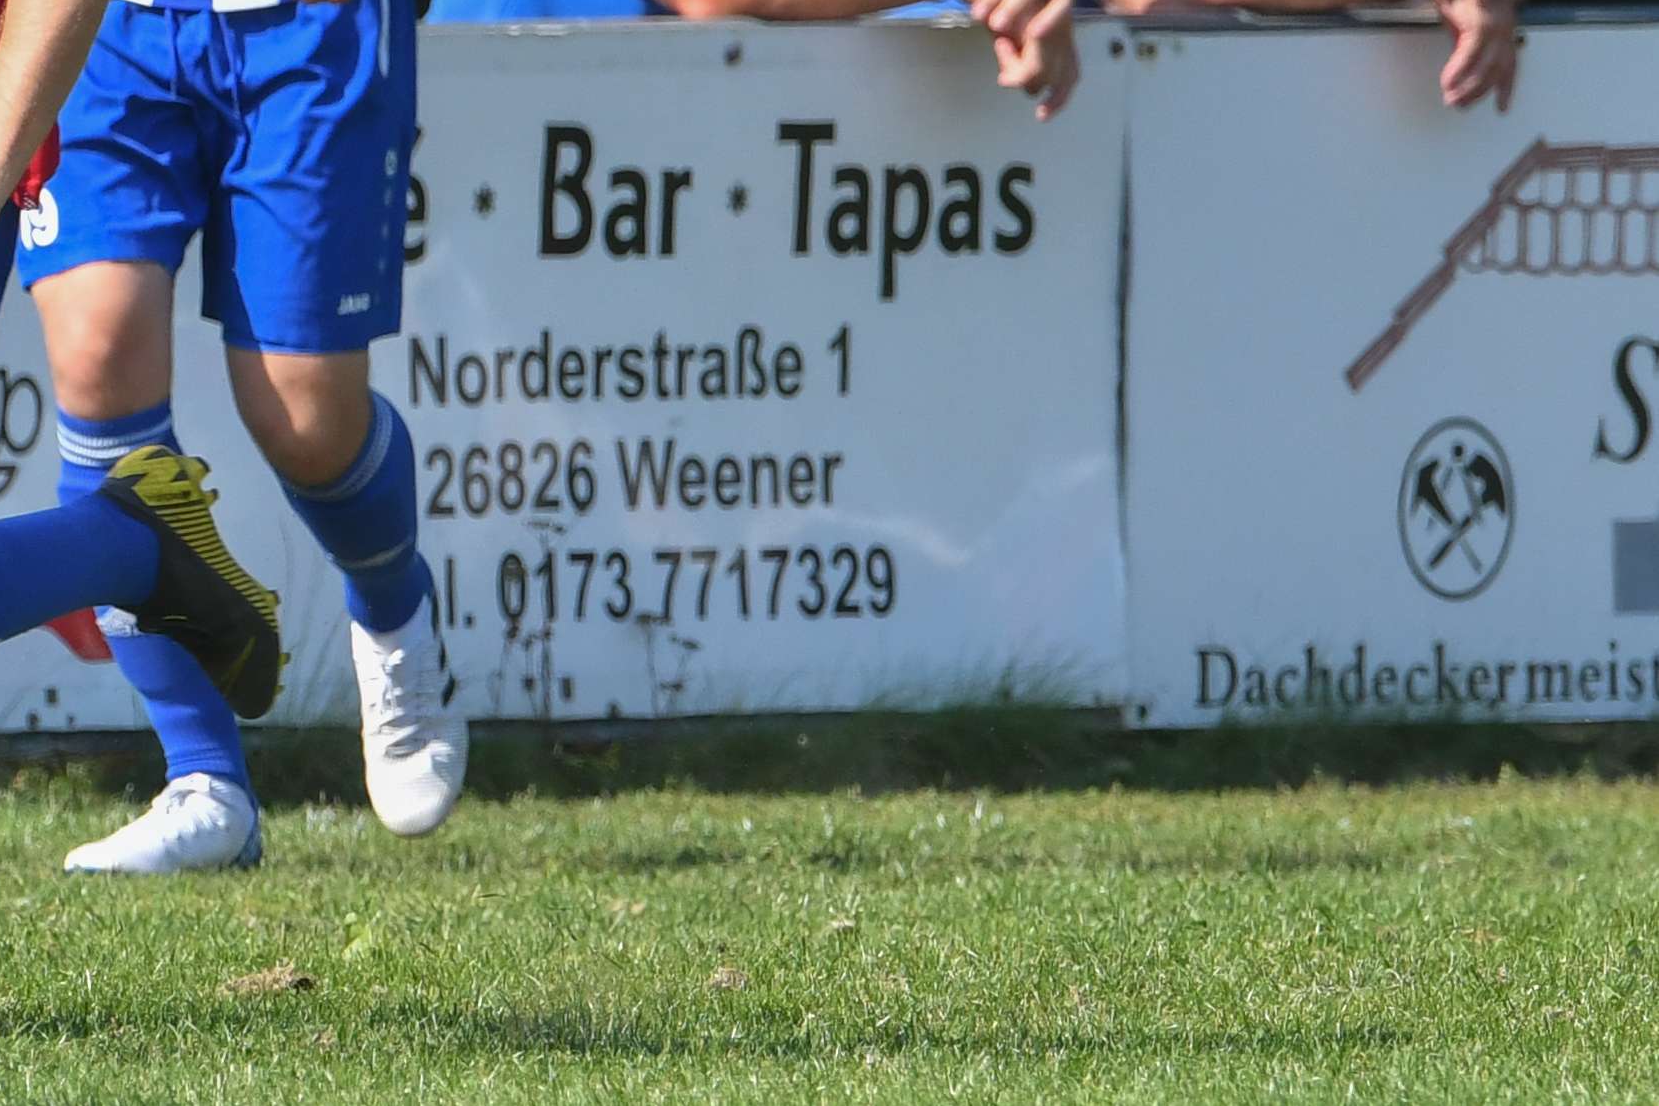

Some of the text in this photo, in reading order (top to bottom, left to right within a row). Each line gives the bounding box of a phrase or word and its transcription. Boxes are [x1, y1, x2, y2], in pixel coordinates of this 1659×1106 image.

[538, 123, 692, 260] Bar
[777, 120, 1034, 301] Tapas
[409, 324, 853, 406] Norderstraße 1
[426, 437, 843, 518] 26826 Weener
